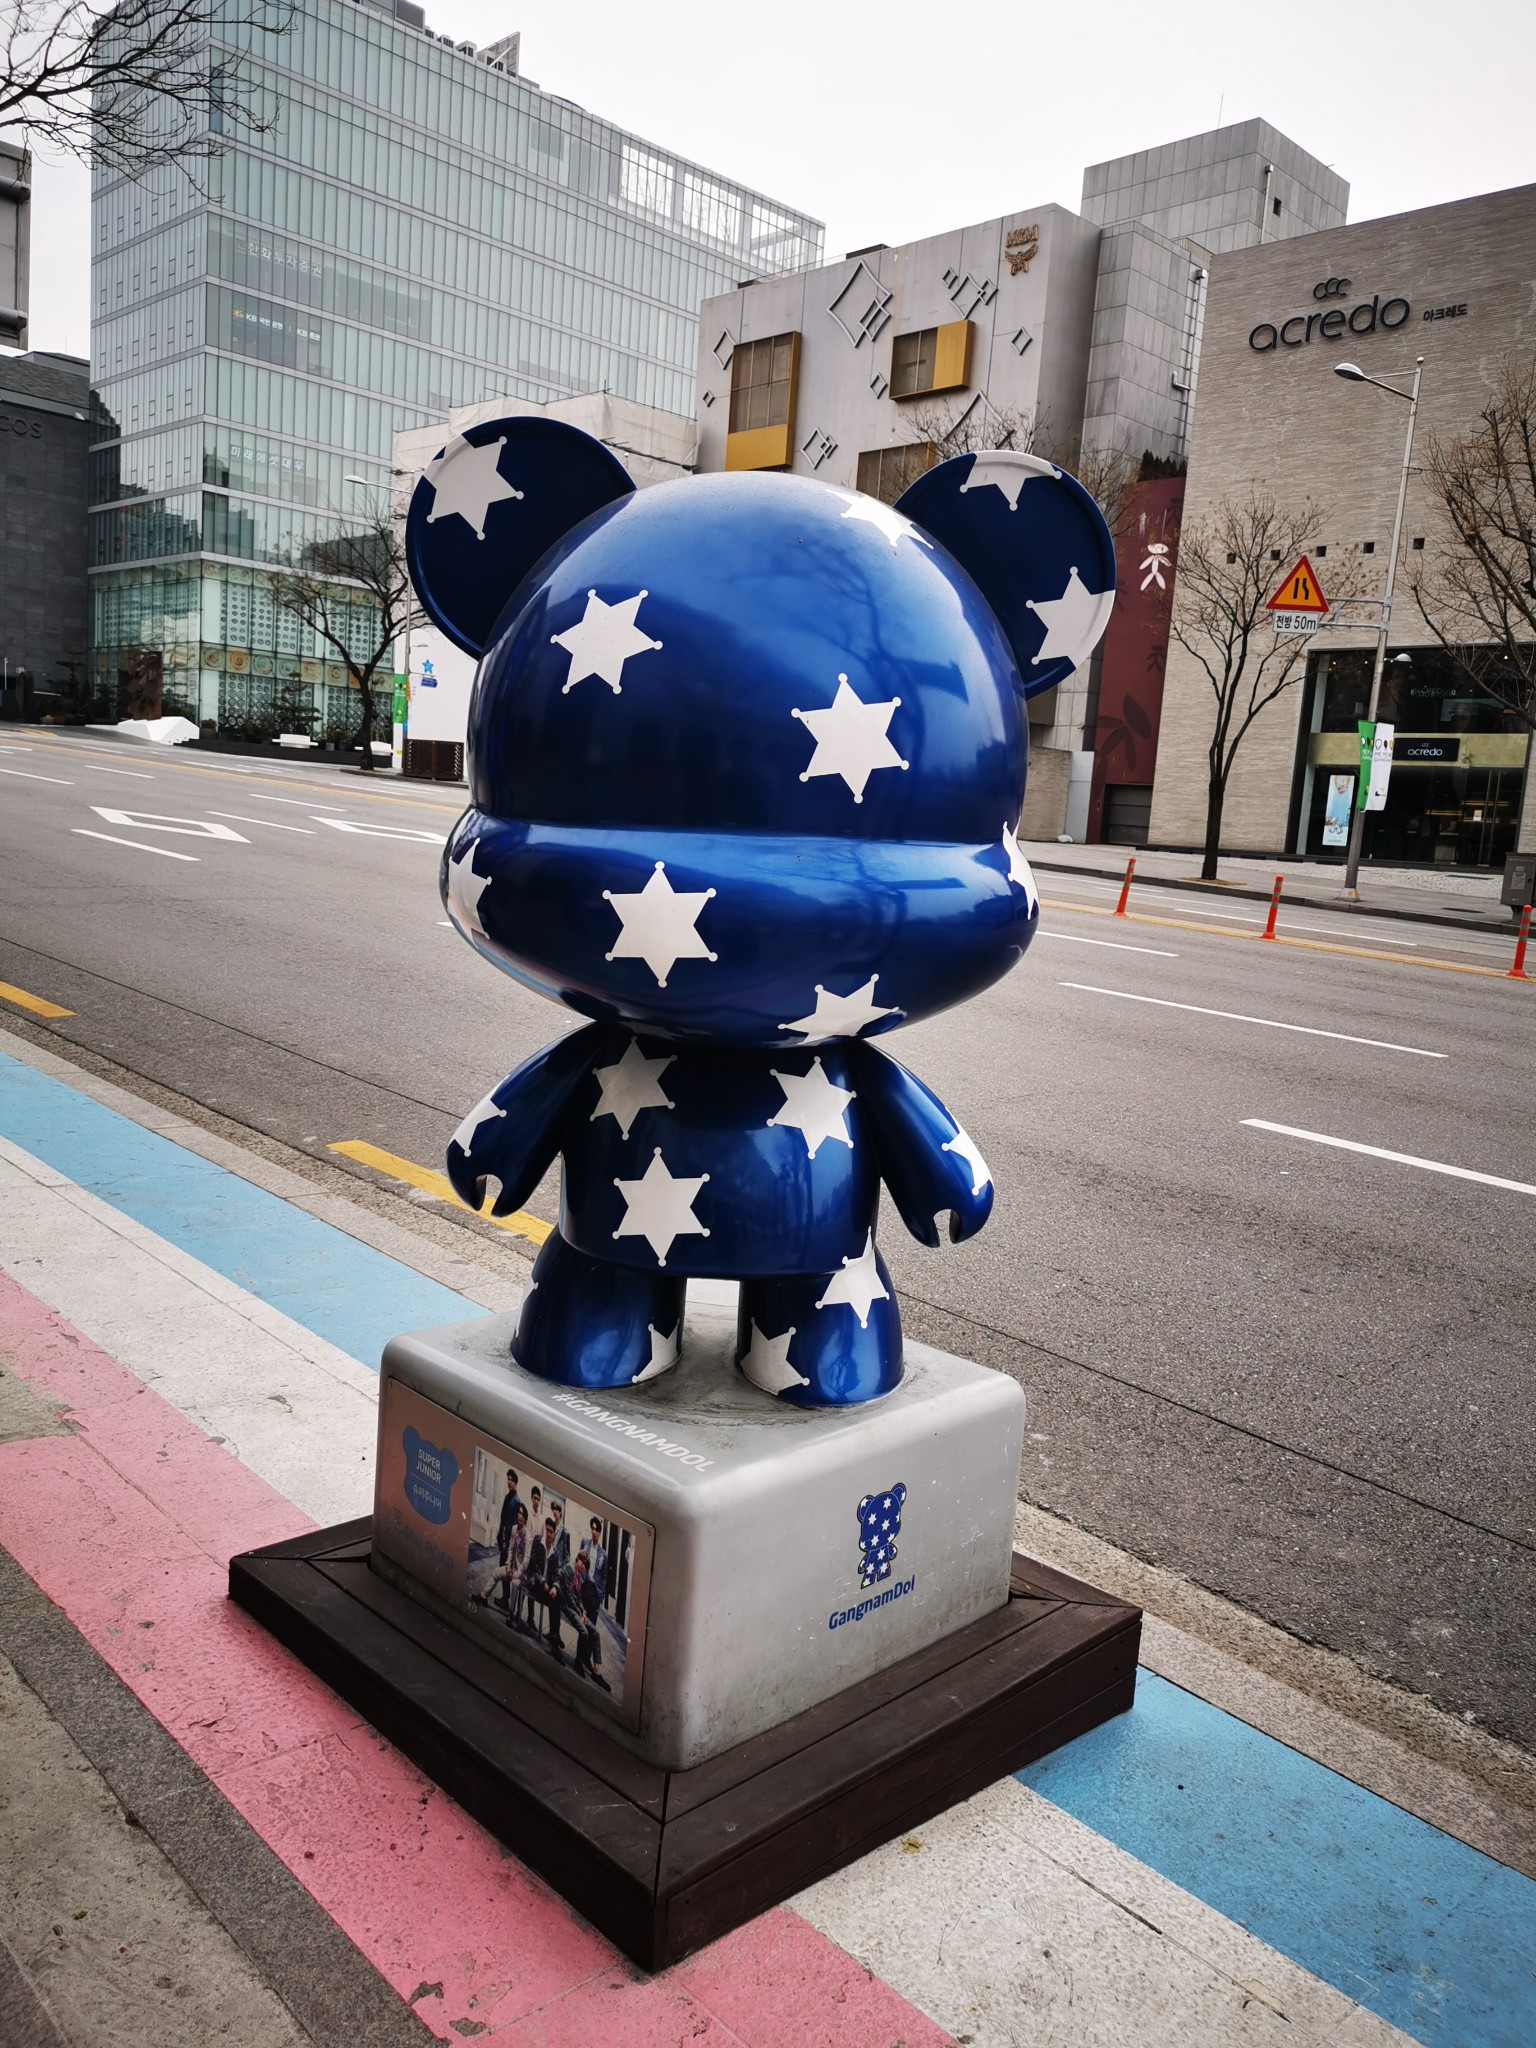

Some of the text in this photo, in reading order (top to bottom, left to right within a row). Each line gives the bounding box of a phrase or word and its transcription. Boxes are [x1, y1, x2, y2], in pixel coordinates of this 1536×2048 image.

[247, 242, 322, 278] 한화투자증권
[245, 312, 258, 322] KB
[1249, 294, 1411, 351] acredo
[1423, 303, 1468, 323] 아크레도
[296, 327, 308, 337] KB
[230, 445, 305, 471] 미래에셋대우
[1276, 614, 1317, 630] 전방 50m
[1407, 747, 1443, 757] acredo
[552, 1393, 715, 1473] #GANGNAMDOL
[418, 1448, 441, 1471] SUPER
[415, 1460, 442, 1485] JUNIOR
[412, 1483, 442, 1511] 슈퍼주니어
[828, 1574, 915, 1630] GangnamDol
